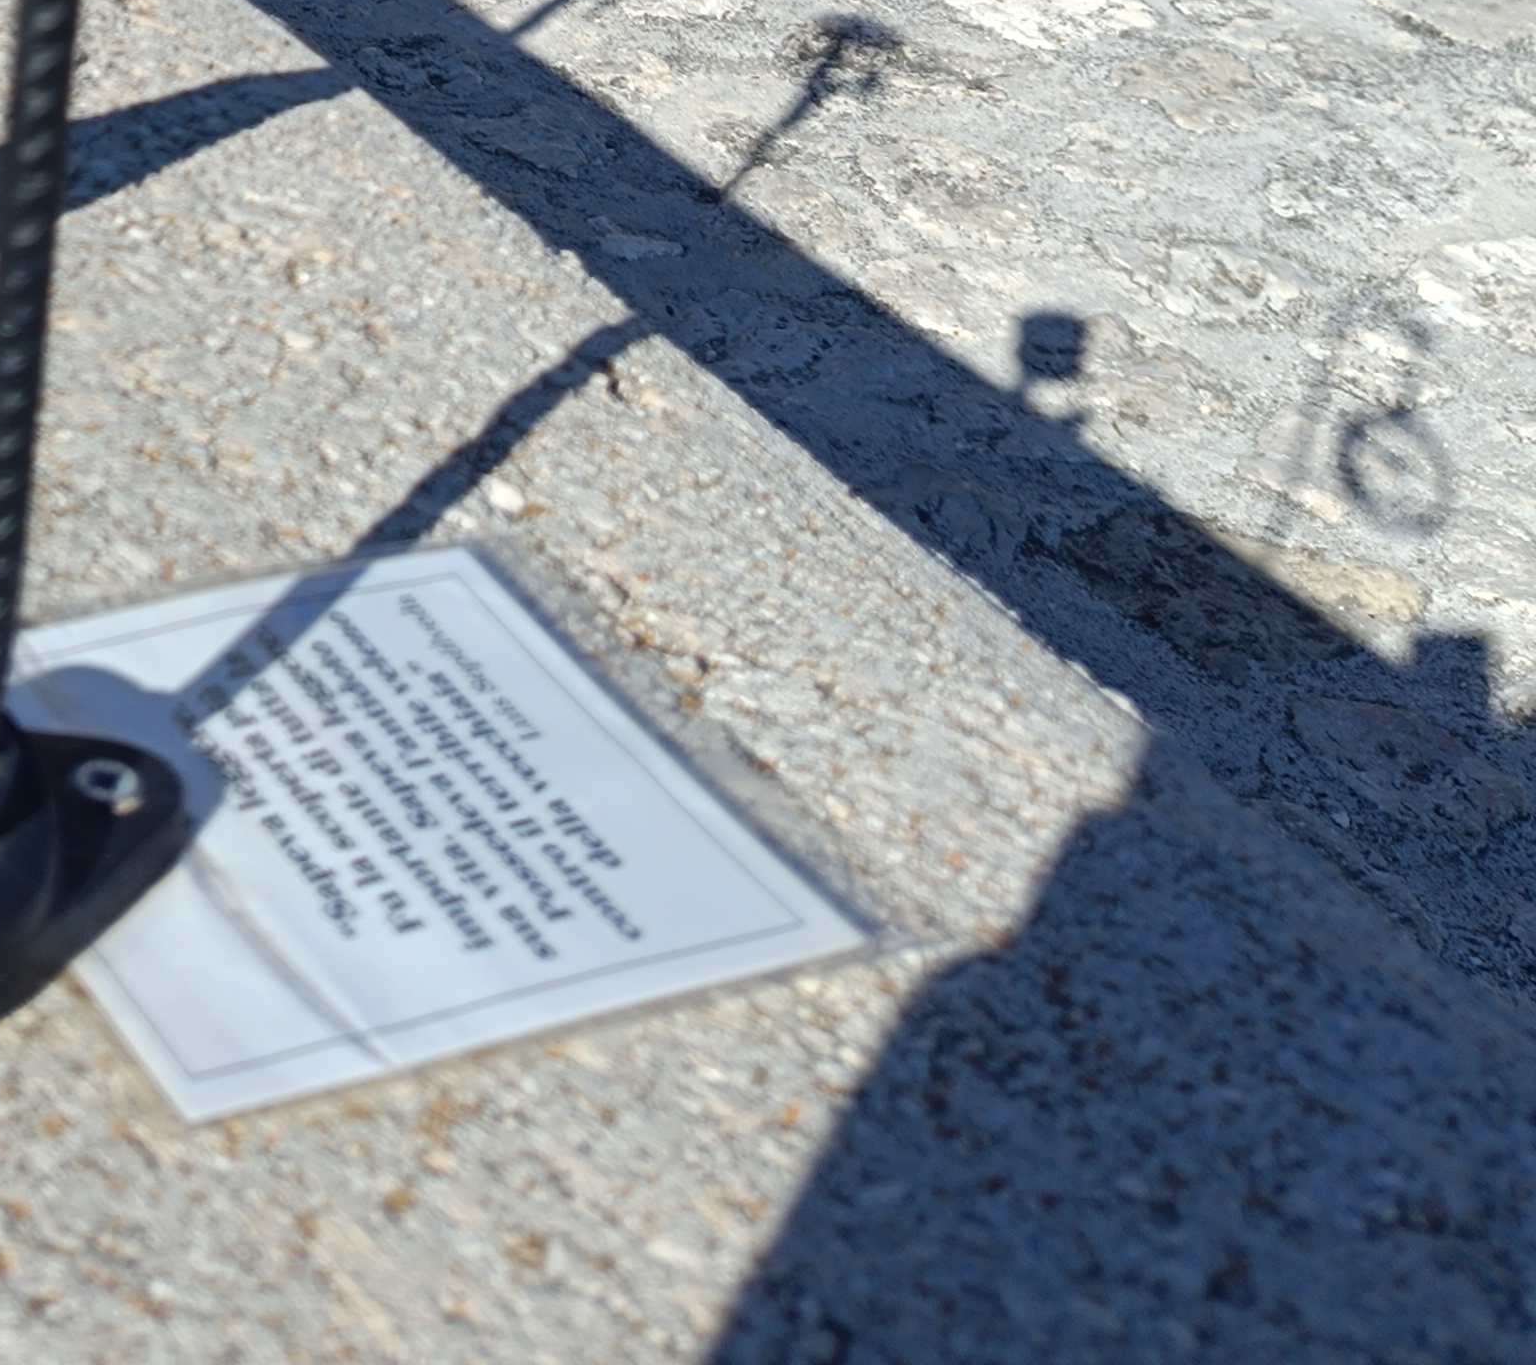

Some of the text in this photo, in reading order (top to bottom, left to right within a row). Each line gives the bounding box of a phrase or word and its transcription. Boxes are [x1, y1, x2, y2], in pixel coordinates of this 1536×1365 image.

[249, 681, 314, 745] tutta
[494, 696, 542, 742] Luis
[245, 733, 354, 850] scoperta
[300, 747, 343, 777] di
[328, 611, 642, 941] contro il terribile veleno
[344, 730, 438, 829] Sapeva
[429, 772, 573, 921] Possedeva
[547, 797, 621, 868] della
[339, 783, 491, 950] importante
[350, 855, 385, 889] la
[379, 889, 426, 934] Fu
[498, 904, 556, 959] sua
